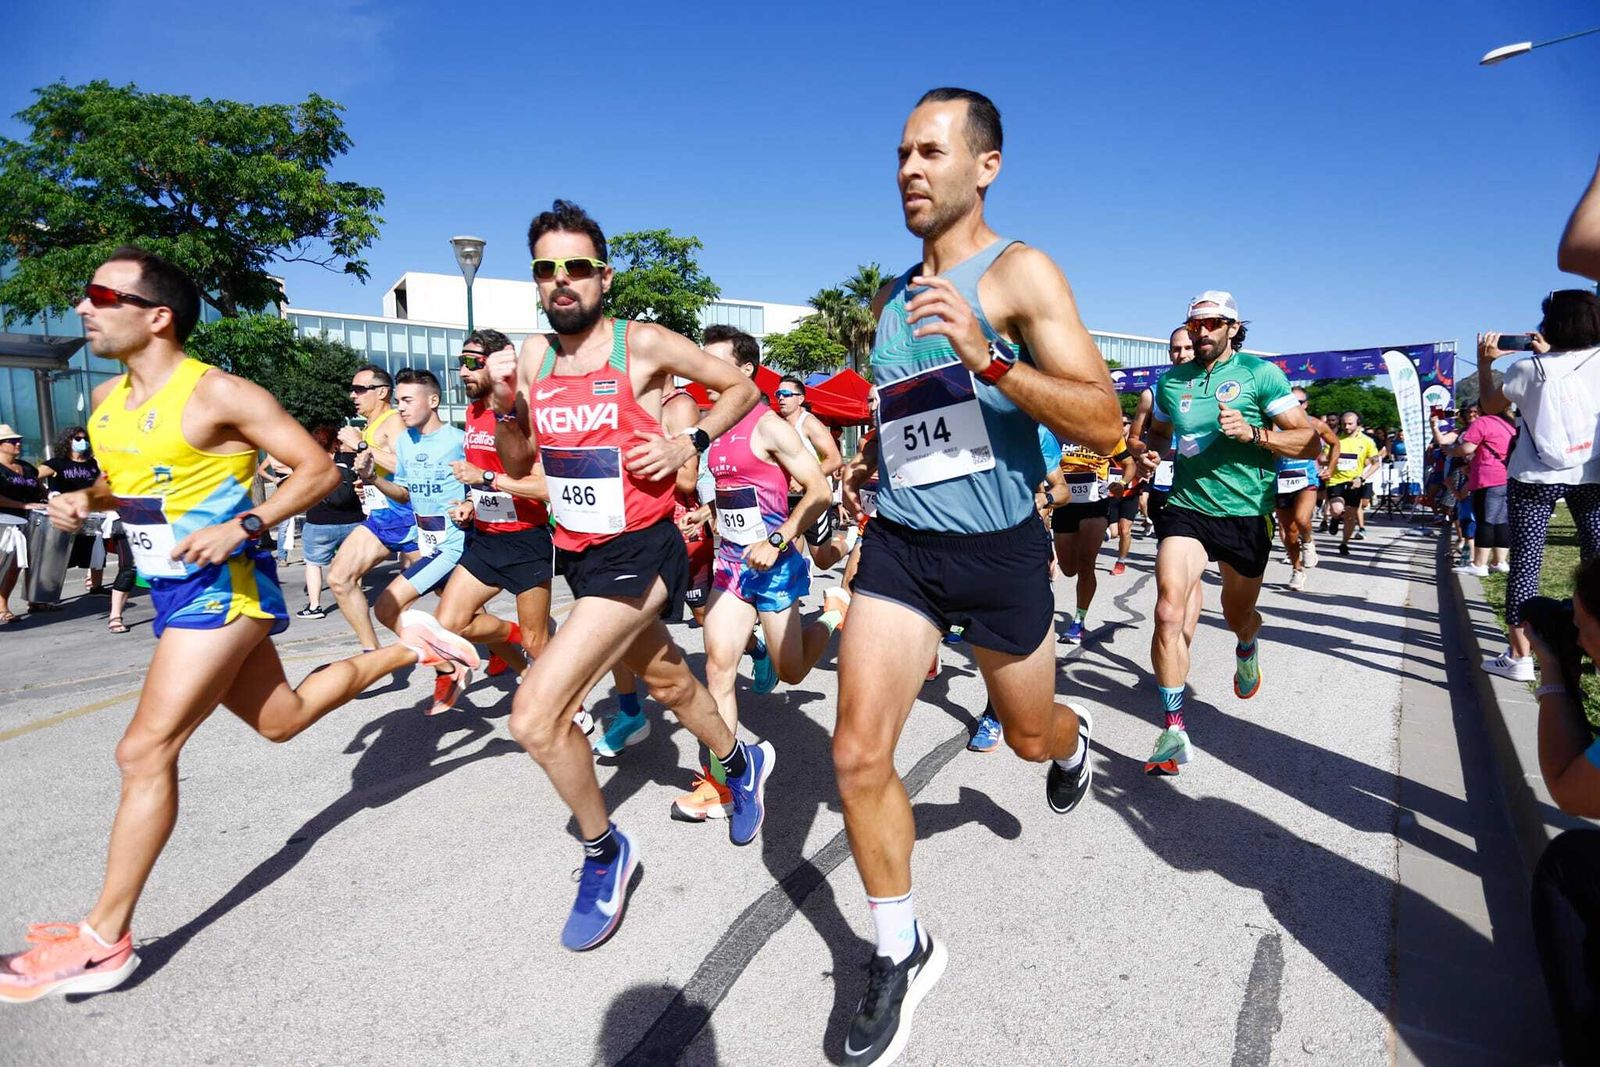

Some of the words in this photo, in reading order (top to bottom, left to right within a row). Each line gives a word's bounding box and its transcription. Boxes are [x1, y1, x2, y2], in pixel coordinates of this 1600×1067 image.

[535, 402, 618, 434] KENYA
[903, 416, 951, 451] 514
[561, 484, 597, 507] 486
[1071, 485, 1088, 494] 633
[479, 495, 500, 508] 464
[724, 513, 746, 528] 619
